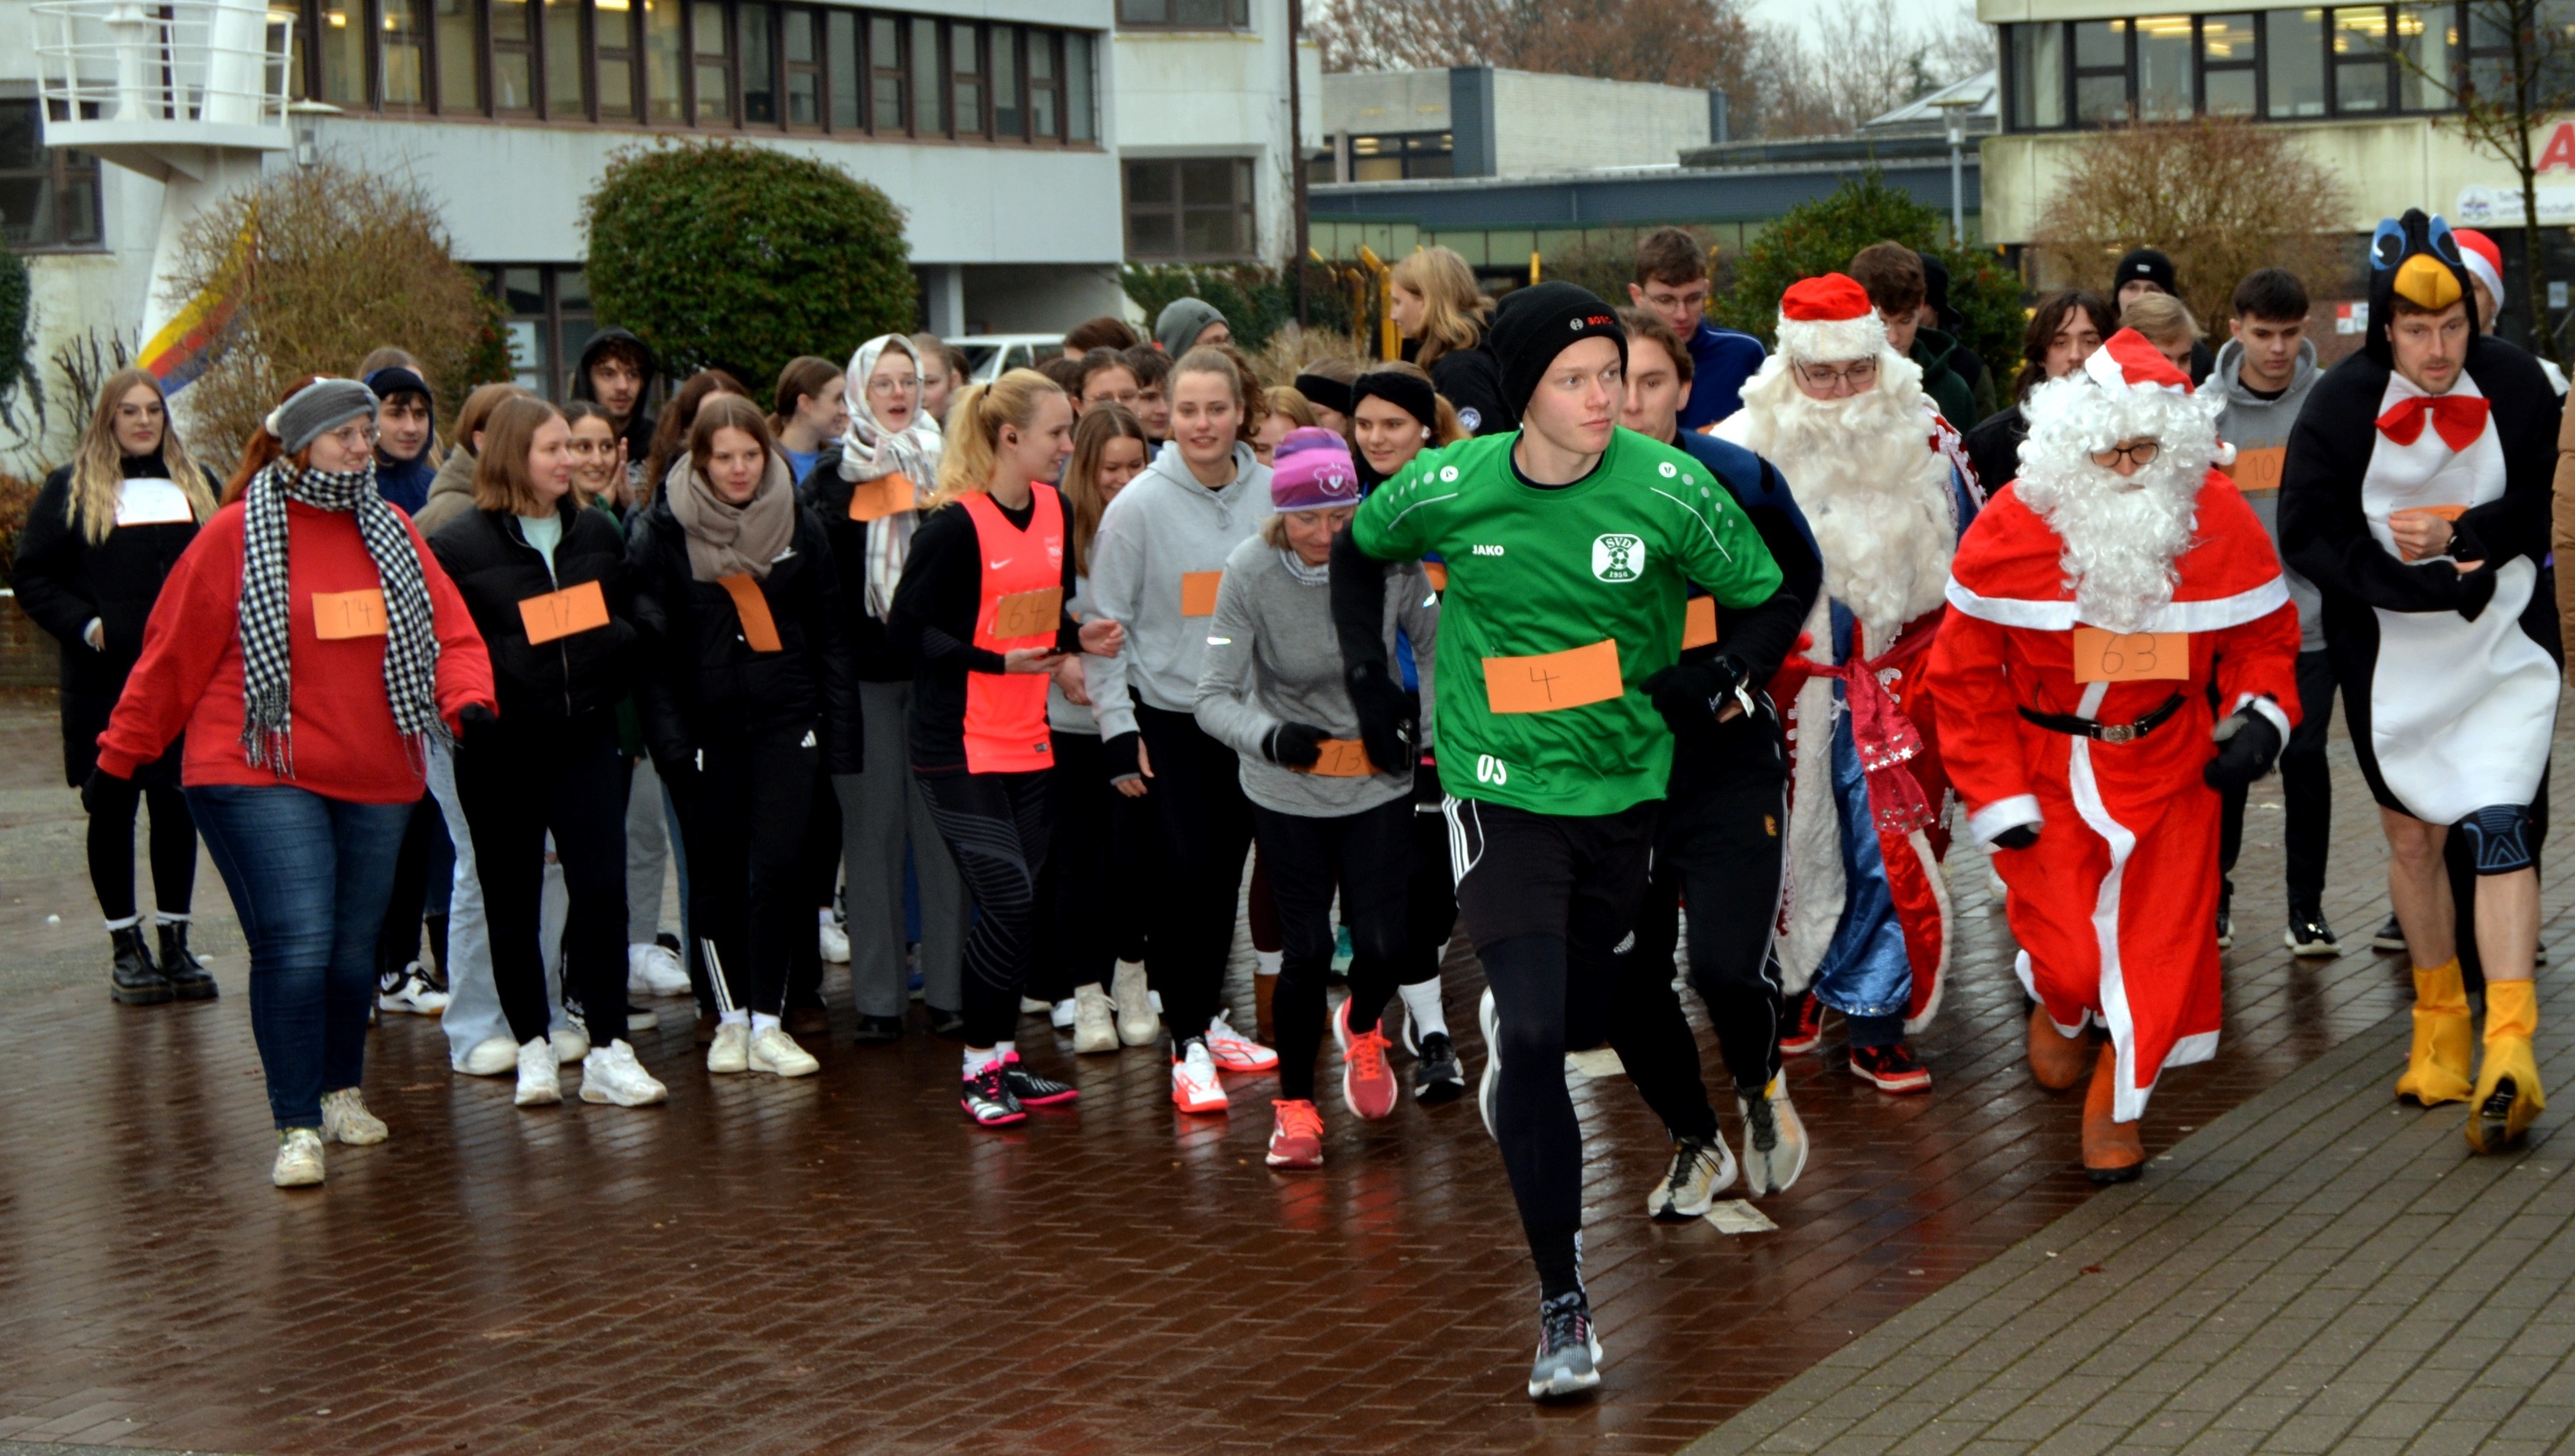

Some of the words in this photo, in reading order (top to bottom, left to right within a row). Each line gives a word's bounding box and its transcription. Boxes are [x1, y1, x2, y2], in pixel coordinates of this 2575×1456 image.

[2248, 454, 2276, 481] 10
[1472, 544, 1504, 556] JAKO
[1605, 537, 1632, 549] SVD
[338, 599, 373, 629] 14
[1009, 597, 1044, 632] 64
[2102, 632, 2157, 675] 63
[1529, 666, 1560, 703] 4
